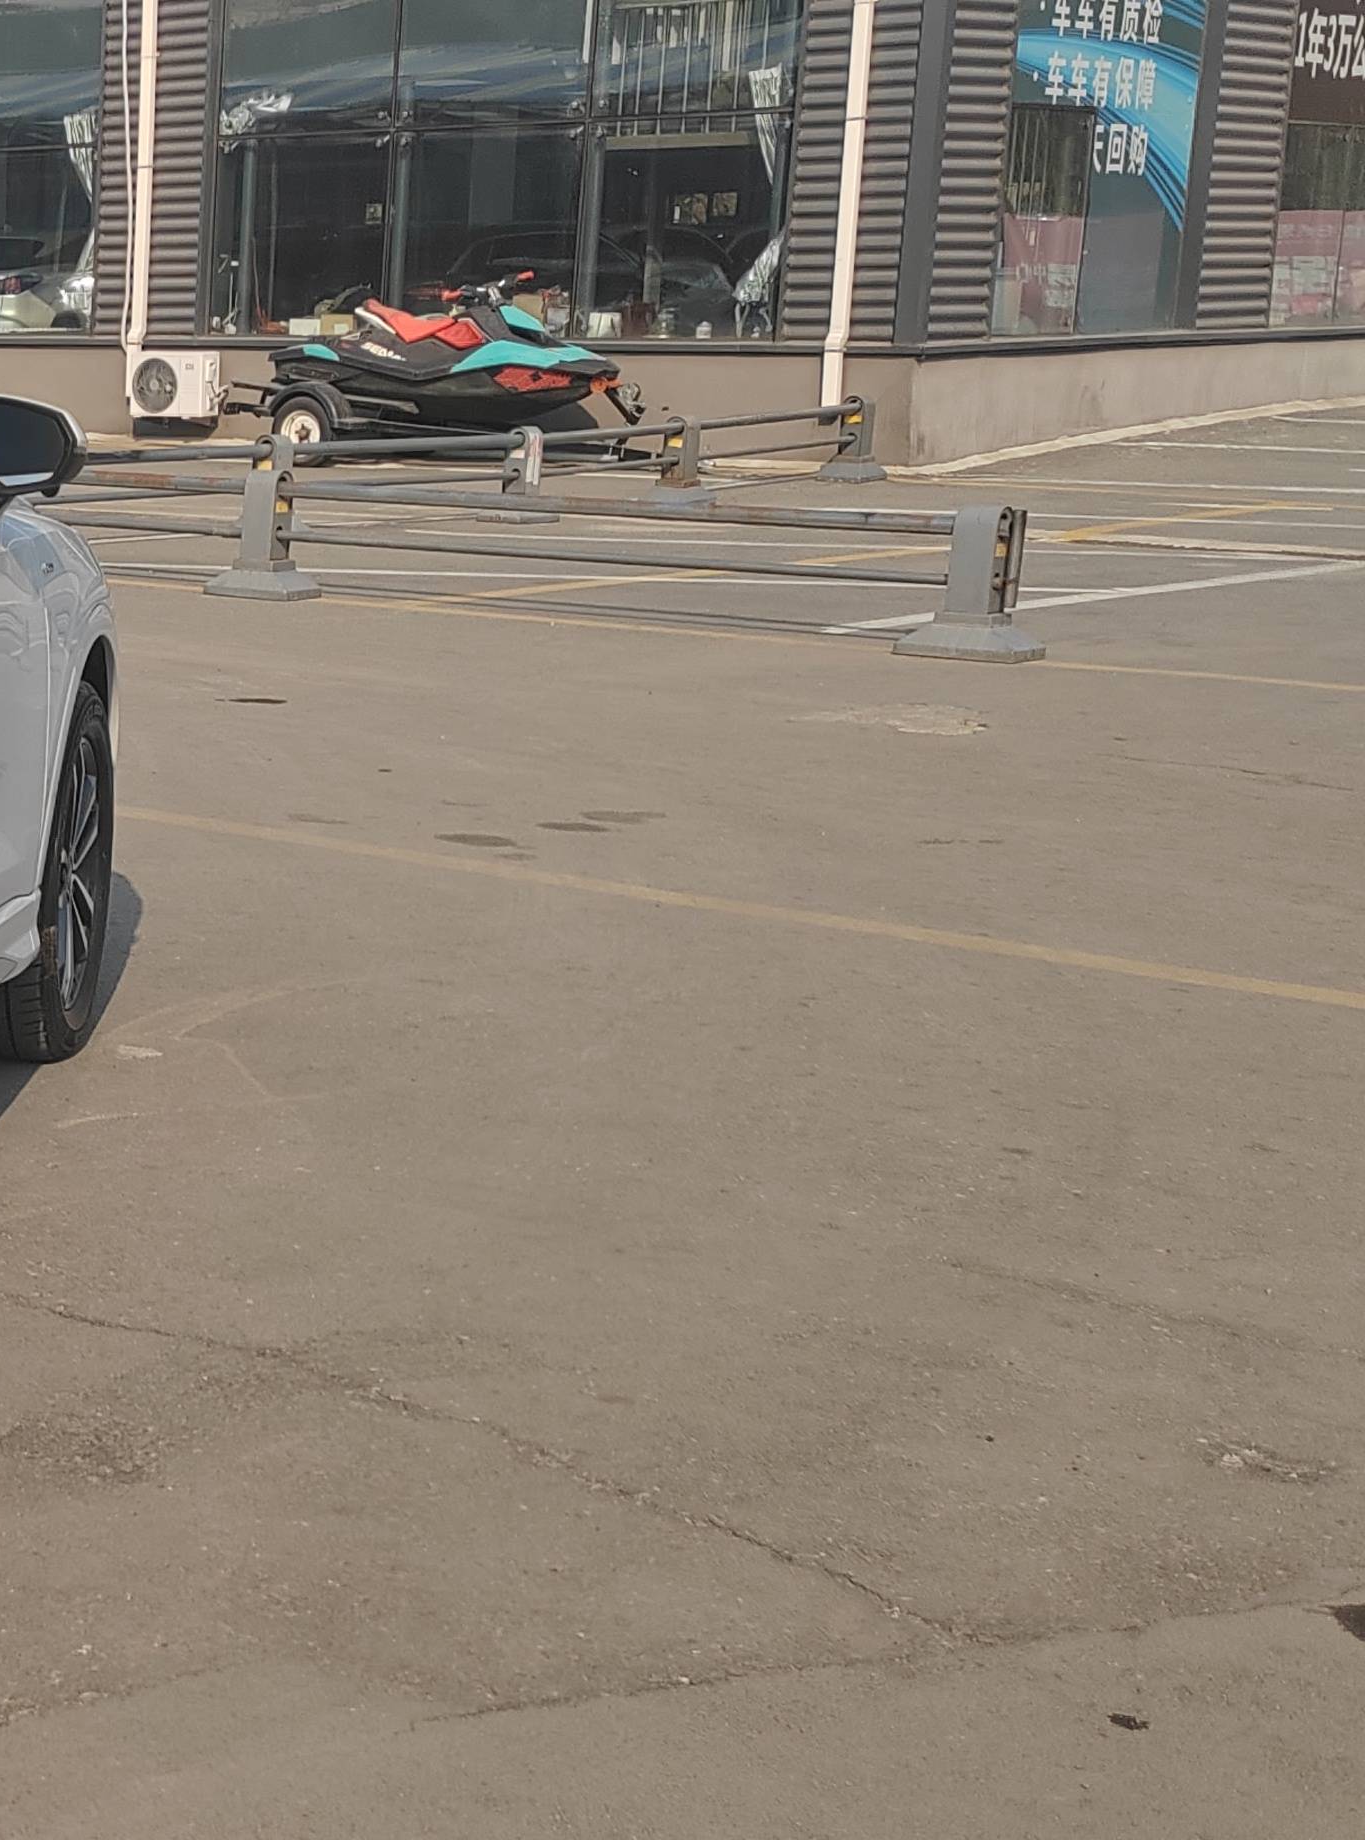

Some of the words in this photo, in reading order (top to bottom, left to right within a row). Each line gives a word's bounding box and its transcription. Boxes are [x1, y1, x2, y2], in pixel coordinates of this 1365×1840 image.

[1051, 0, 1163, 45] 车车有质检
[1044, 50, 1157, 112] 车车有保障
